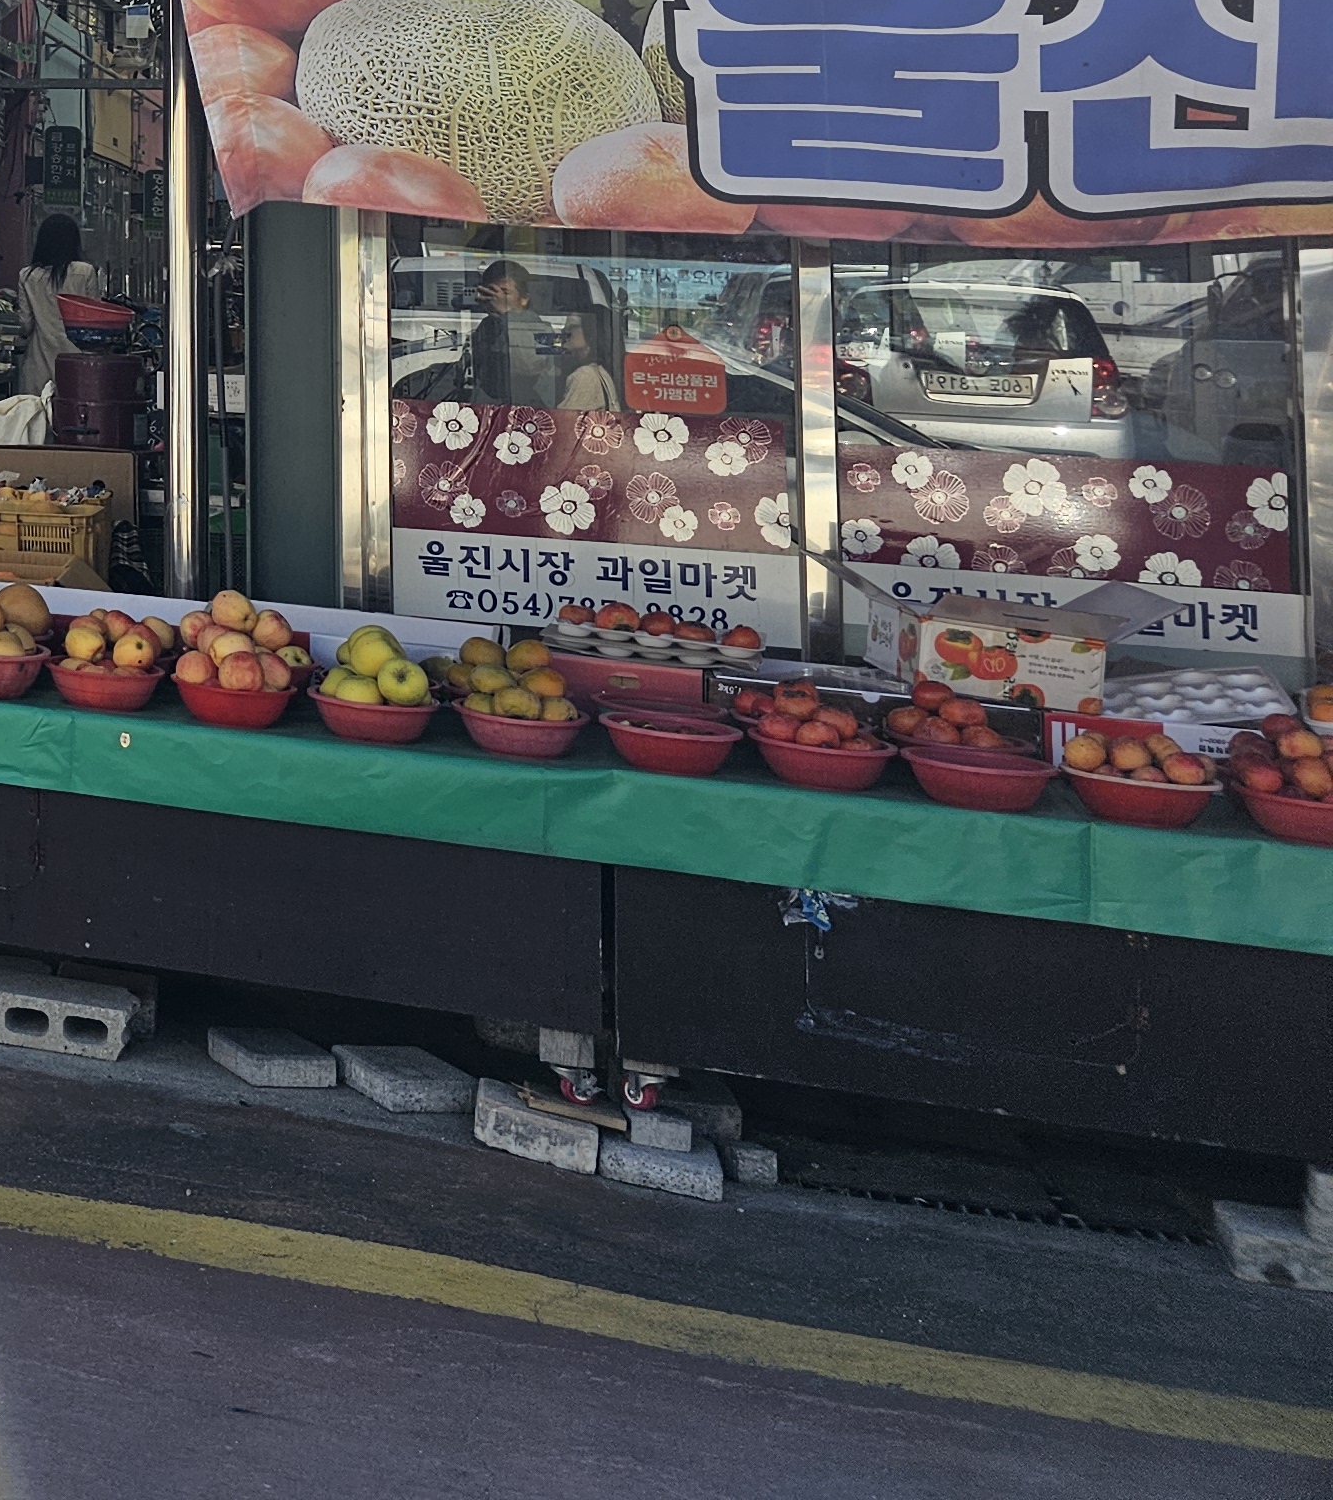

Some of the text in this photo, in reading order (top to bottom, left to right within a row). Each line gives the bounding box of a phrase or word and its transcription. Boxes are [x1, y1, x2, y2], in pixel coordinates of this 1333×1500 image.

[633, 371, 718, 388] 온누리상품권
[654, 388, 698, 402] 가맹점
[418, 540, 759, 602] 울진시장 과일마켓
